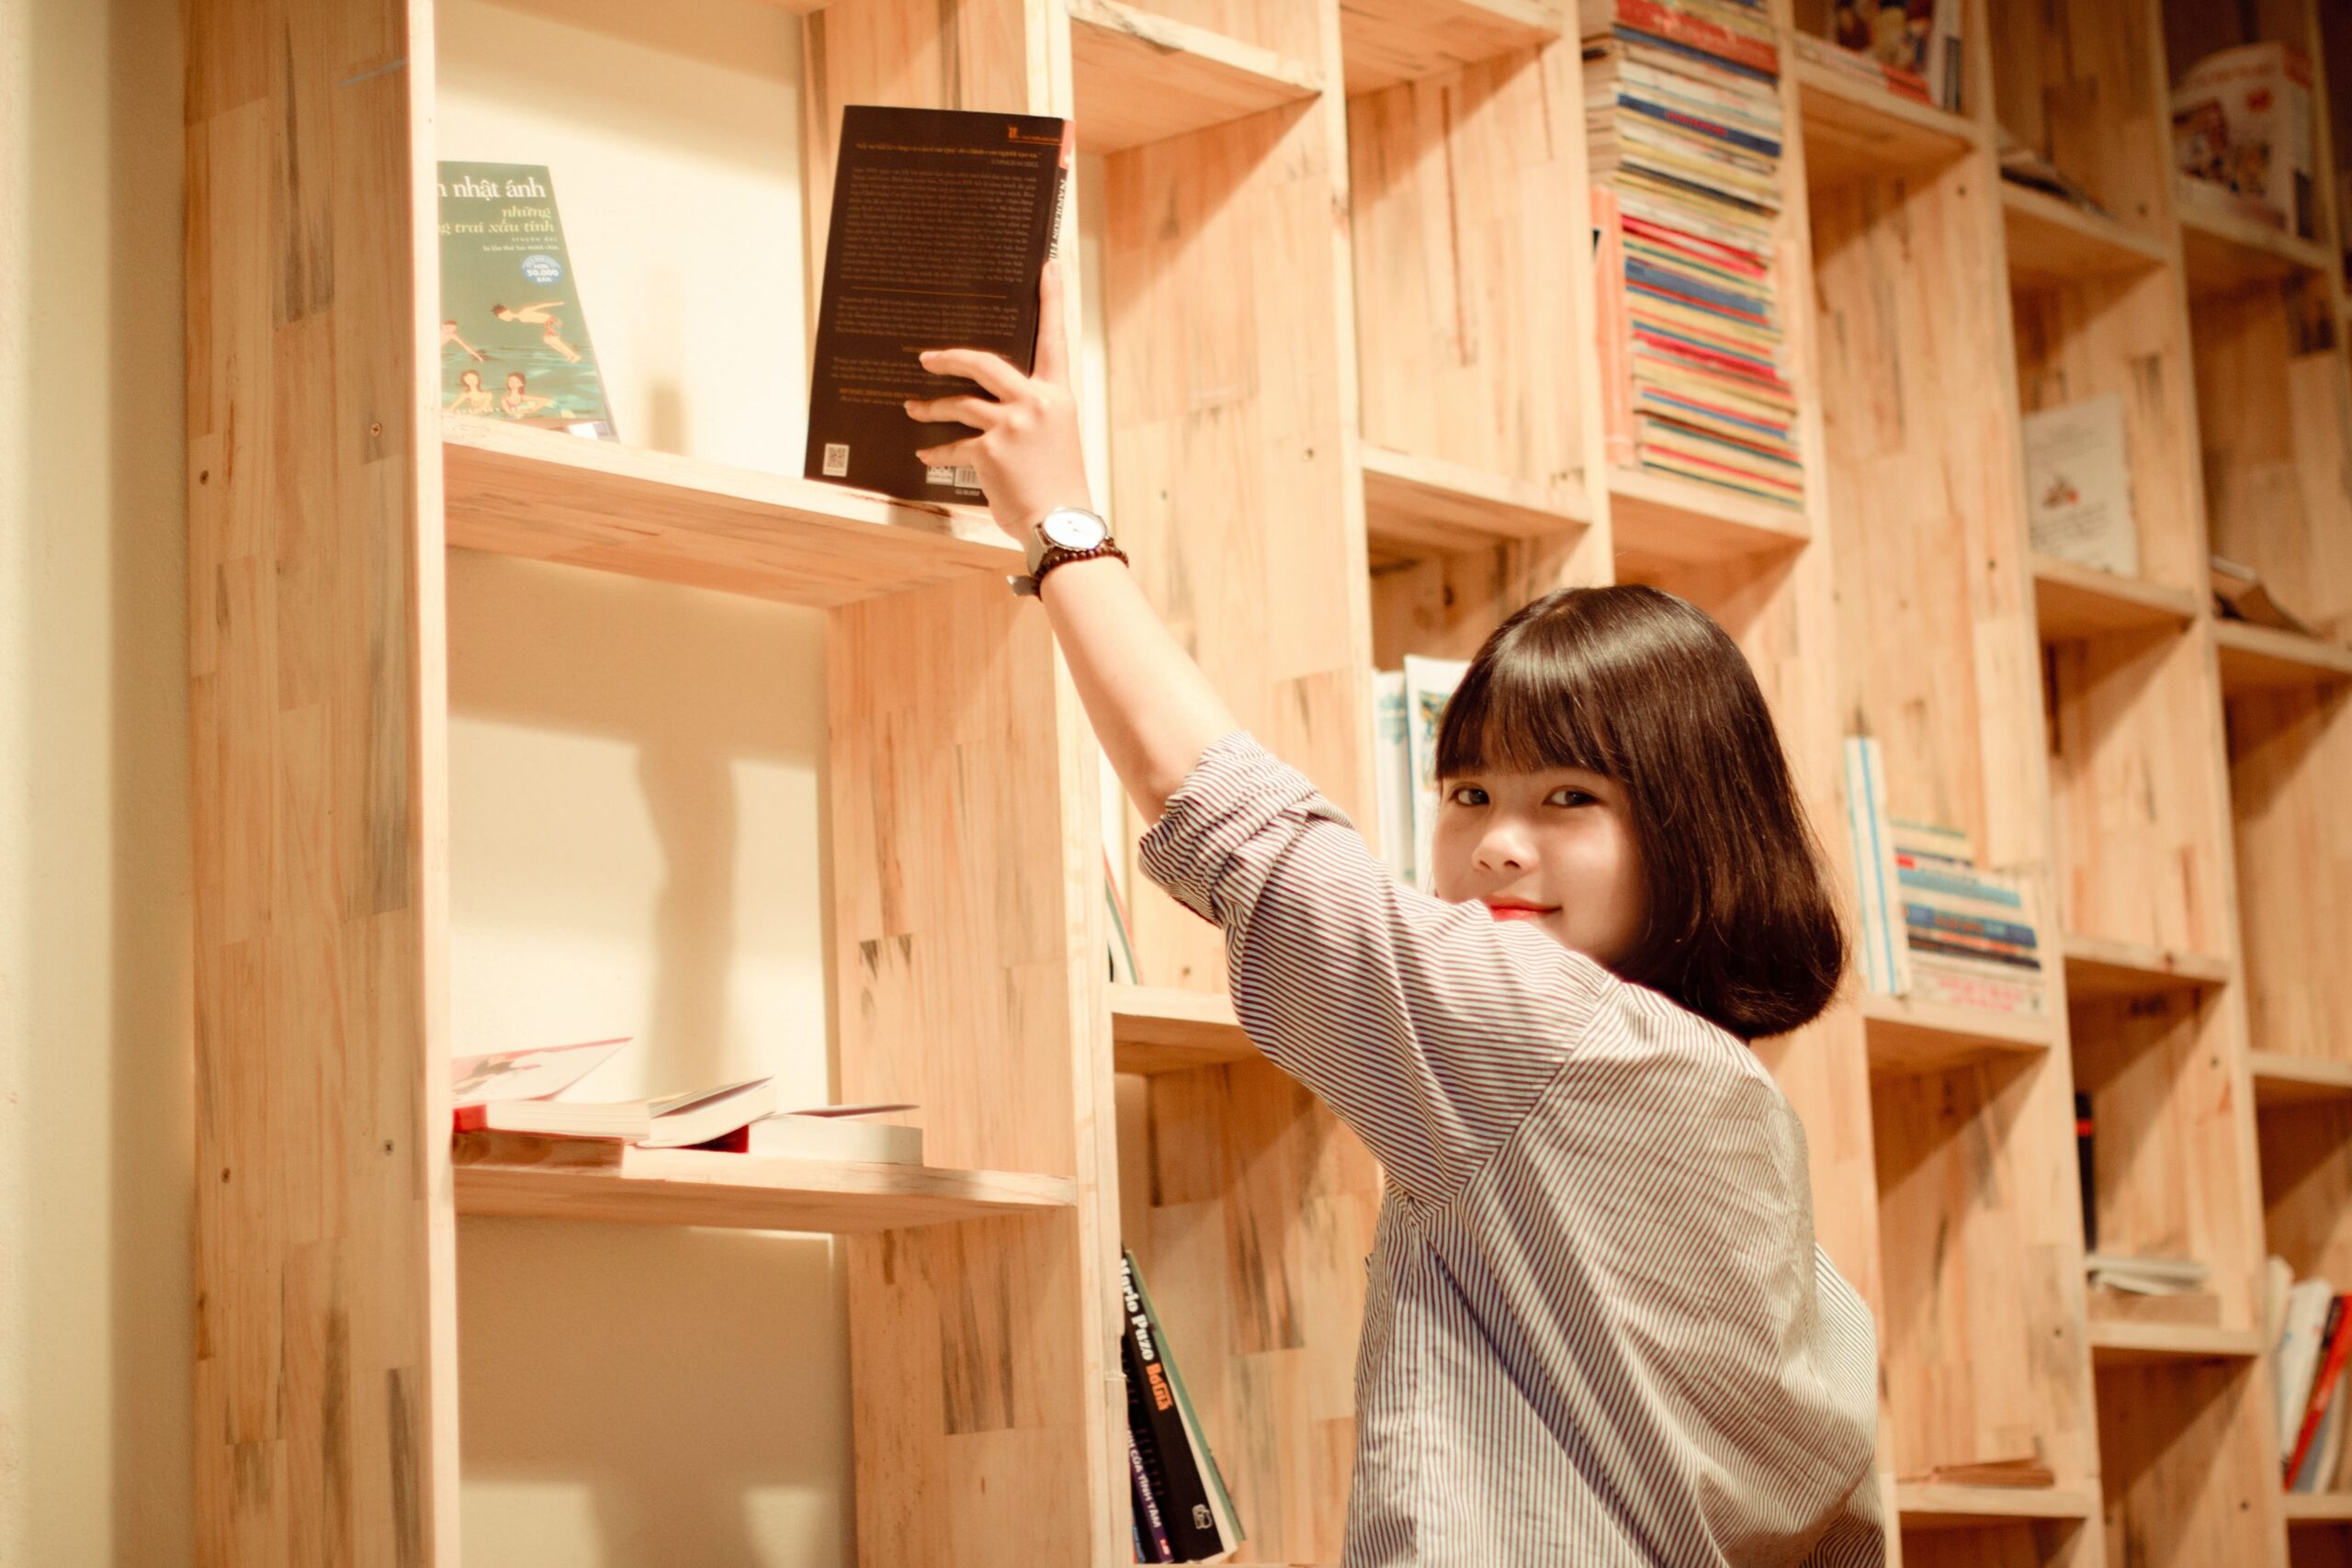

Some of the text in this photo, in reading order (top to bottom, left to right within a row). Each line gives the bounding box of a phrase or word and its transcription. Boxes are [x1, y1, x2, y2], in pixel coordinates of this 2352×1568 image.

[453, 175, 501, 201] nhật
[506, 176, 547, 198] ánh
[502, 205, 551, 220] những
[1052, 178, 1067, 240] NAPOLEON
[455, 221, 484, 233] trai
[488, 219, 519, 233] xấu
[524, 220, 555, 232] tính
[1131, 1314, 1155, 1361] Puzo
[1148, 1502, 1161, 1528] TÂM
